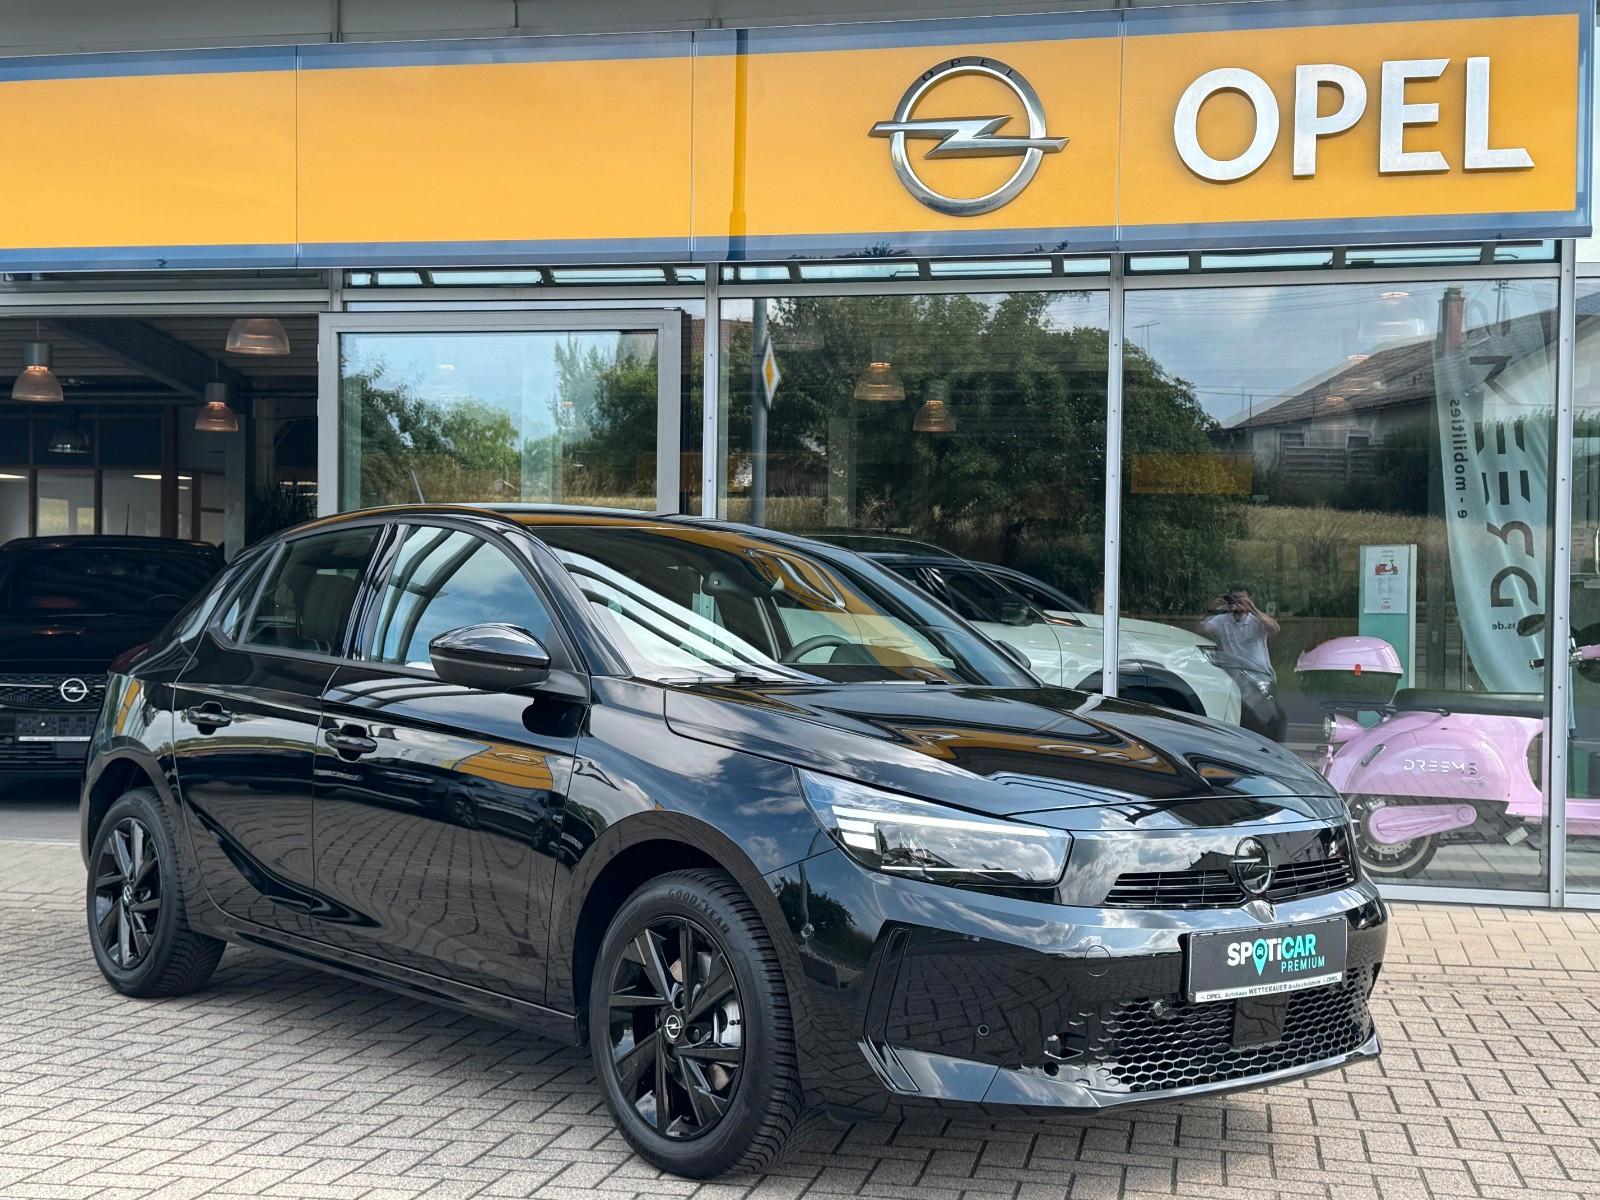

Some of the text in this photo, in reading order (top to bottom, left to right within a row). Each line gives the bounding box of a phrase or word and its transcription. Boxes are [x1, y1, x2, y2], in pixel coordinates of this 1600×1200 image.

[922, 58, 1014, 82] OPEL
[1173, 56, 1535, 181] OPEL
[1281, 956, 1325, 973] PREMIUM
[1248, 983, 1288, 995] WETTERAUER
